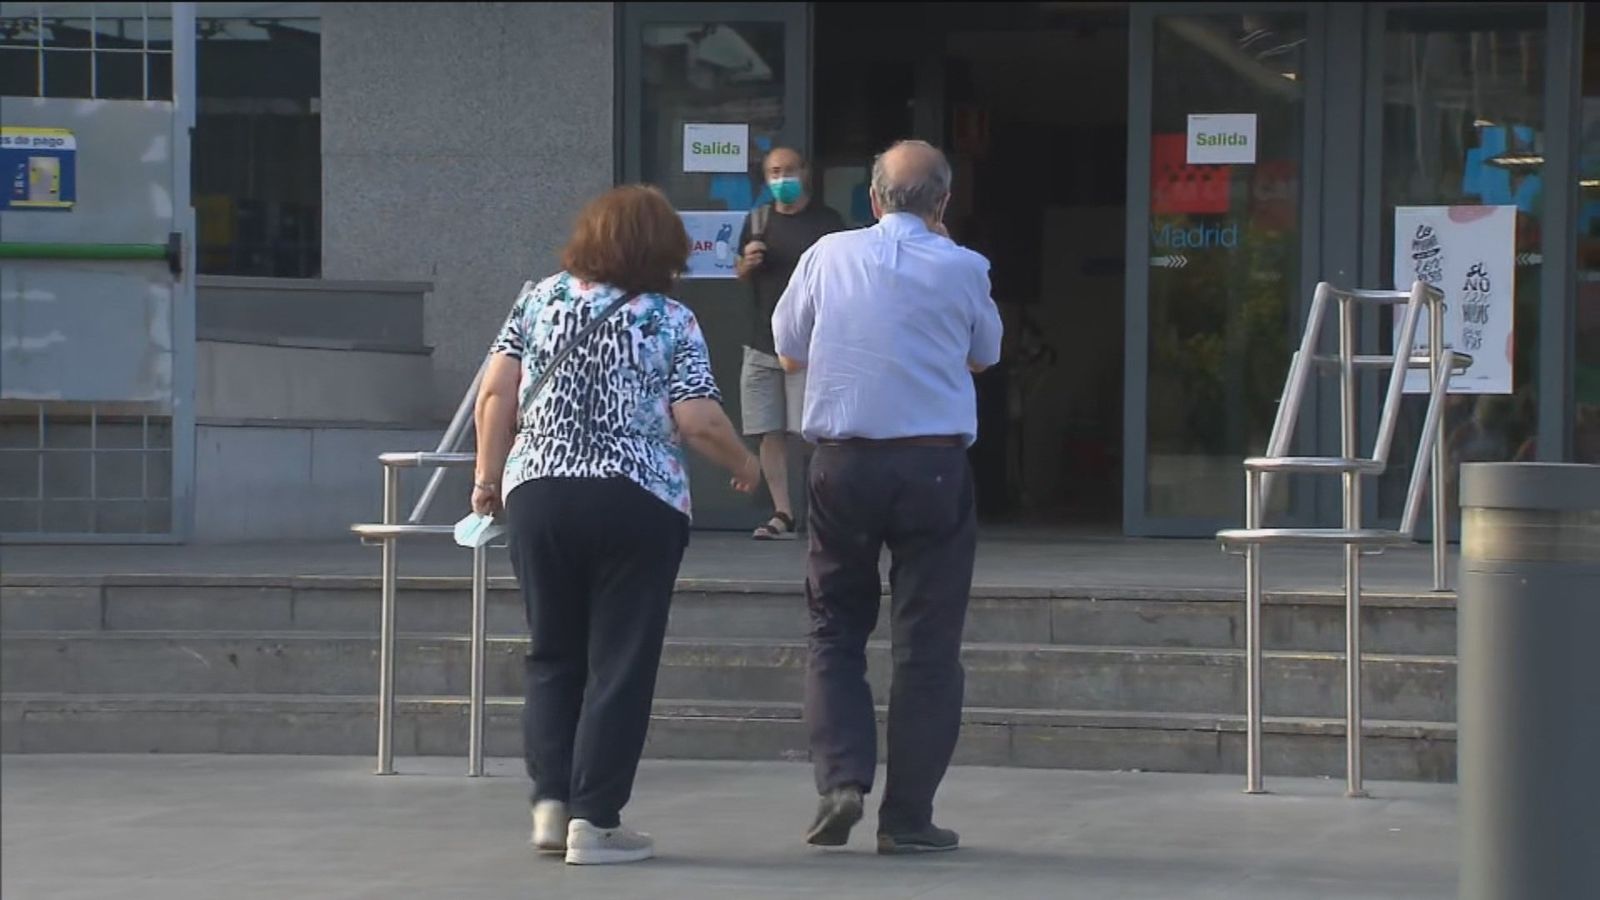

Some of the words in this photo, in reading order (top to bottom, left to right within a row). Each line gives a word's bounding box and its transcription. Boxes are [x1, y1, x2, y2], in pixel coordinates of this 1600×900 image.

[33, 136, 65, 149] pago
[1196, 132, 1248, 146] Salida
[692, 141, 740, 155] Salida
[1151, 223, 1238, 248] Madrid
[1462, 277, 1490, 292] NO
